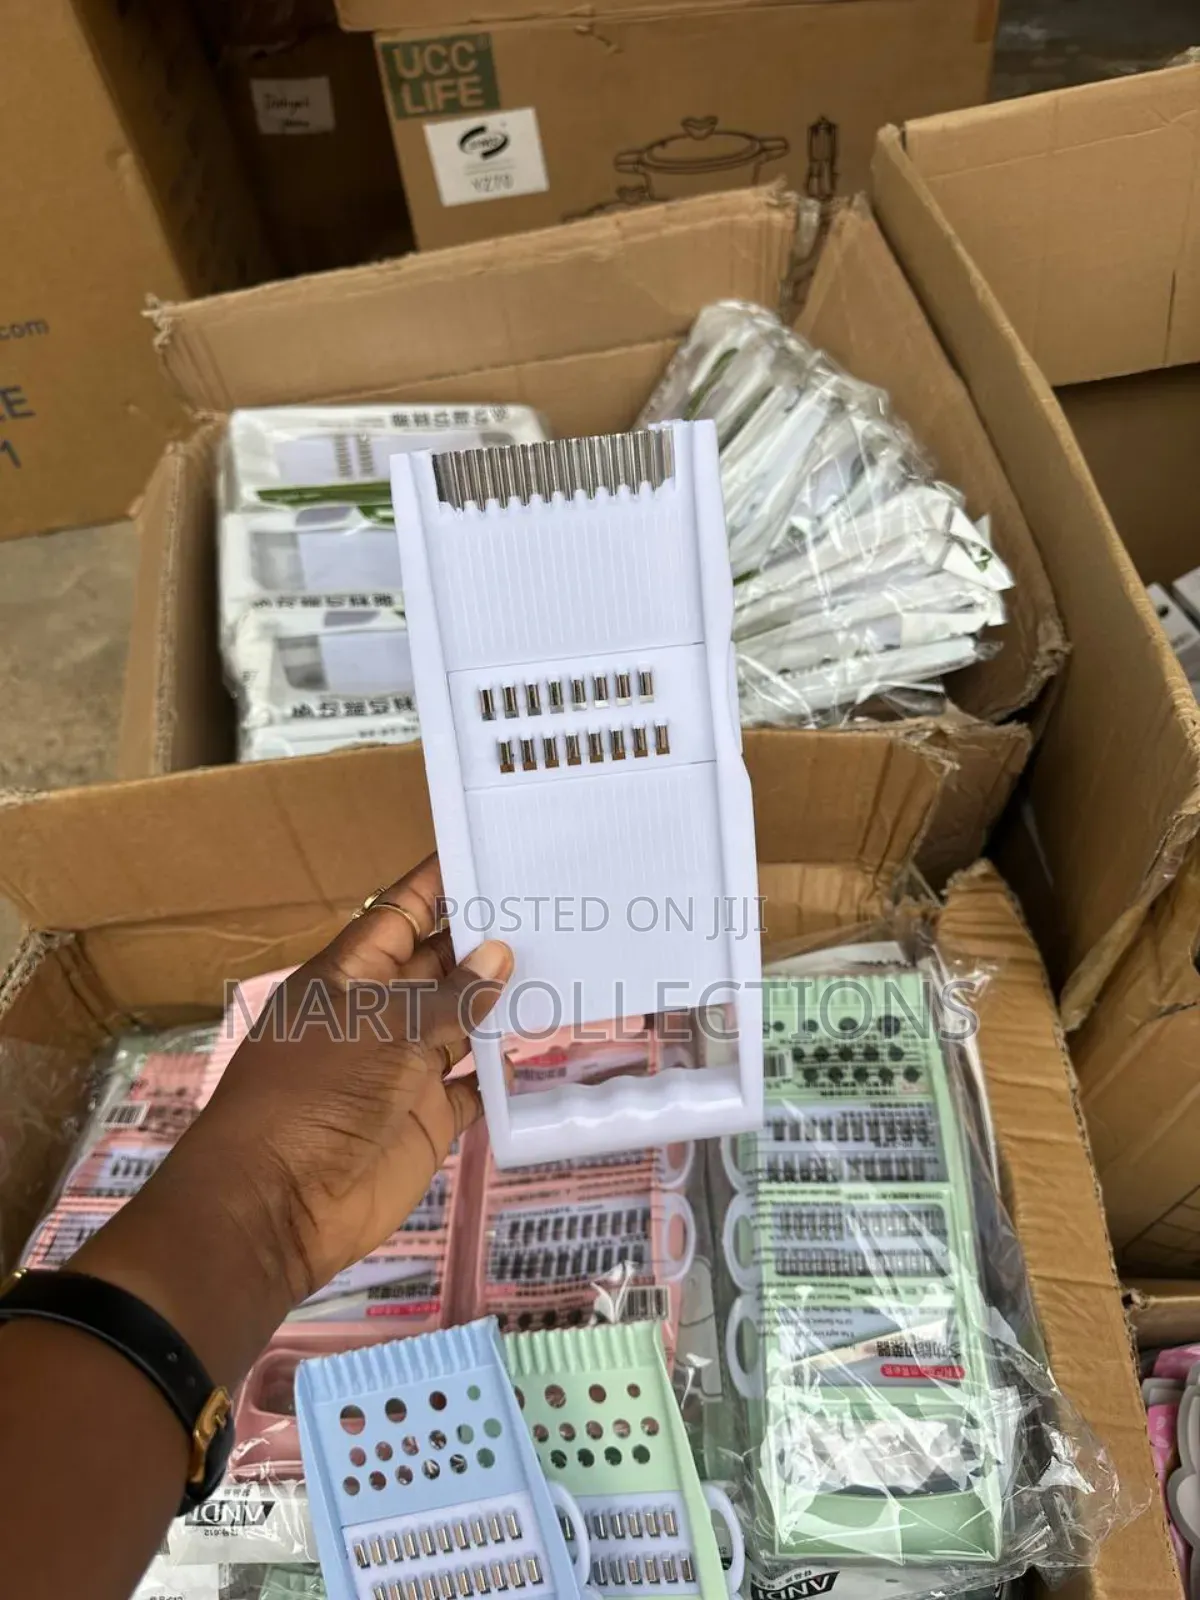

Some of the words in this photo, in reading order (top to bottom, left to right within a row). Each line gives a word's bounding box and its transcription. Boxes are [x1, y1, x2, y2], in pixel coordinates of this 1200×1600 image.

[392, 40, 479, 79] UCC
[401, 75, 486, 114] LIFE
[0, 384, 36, 424] E
